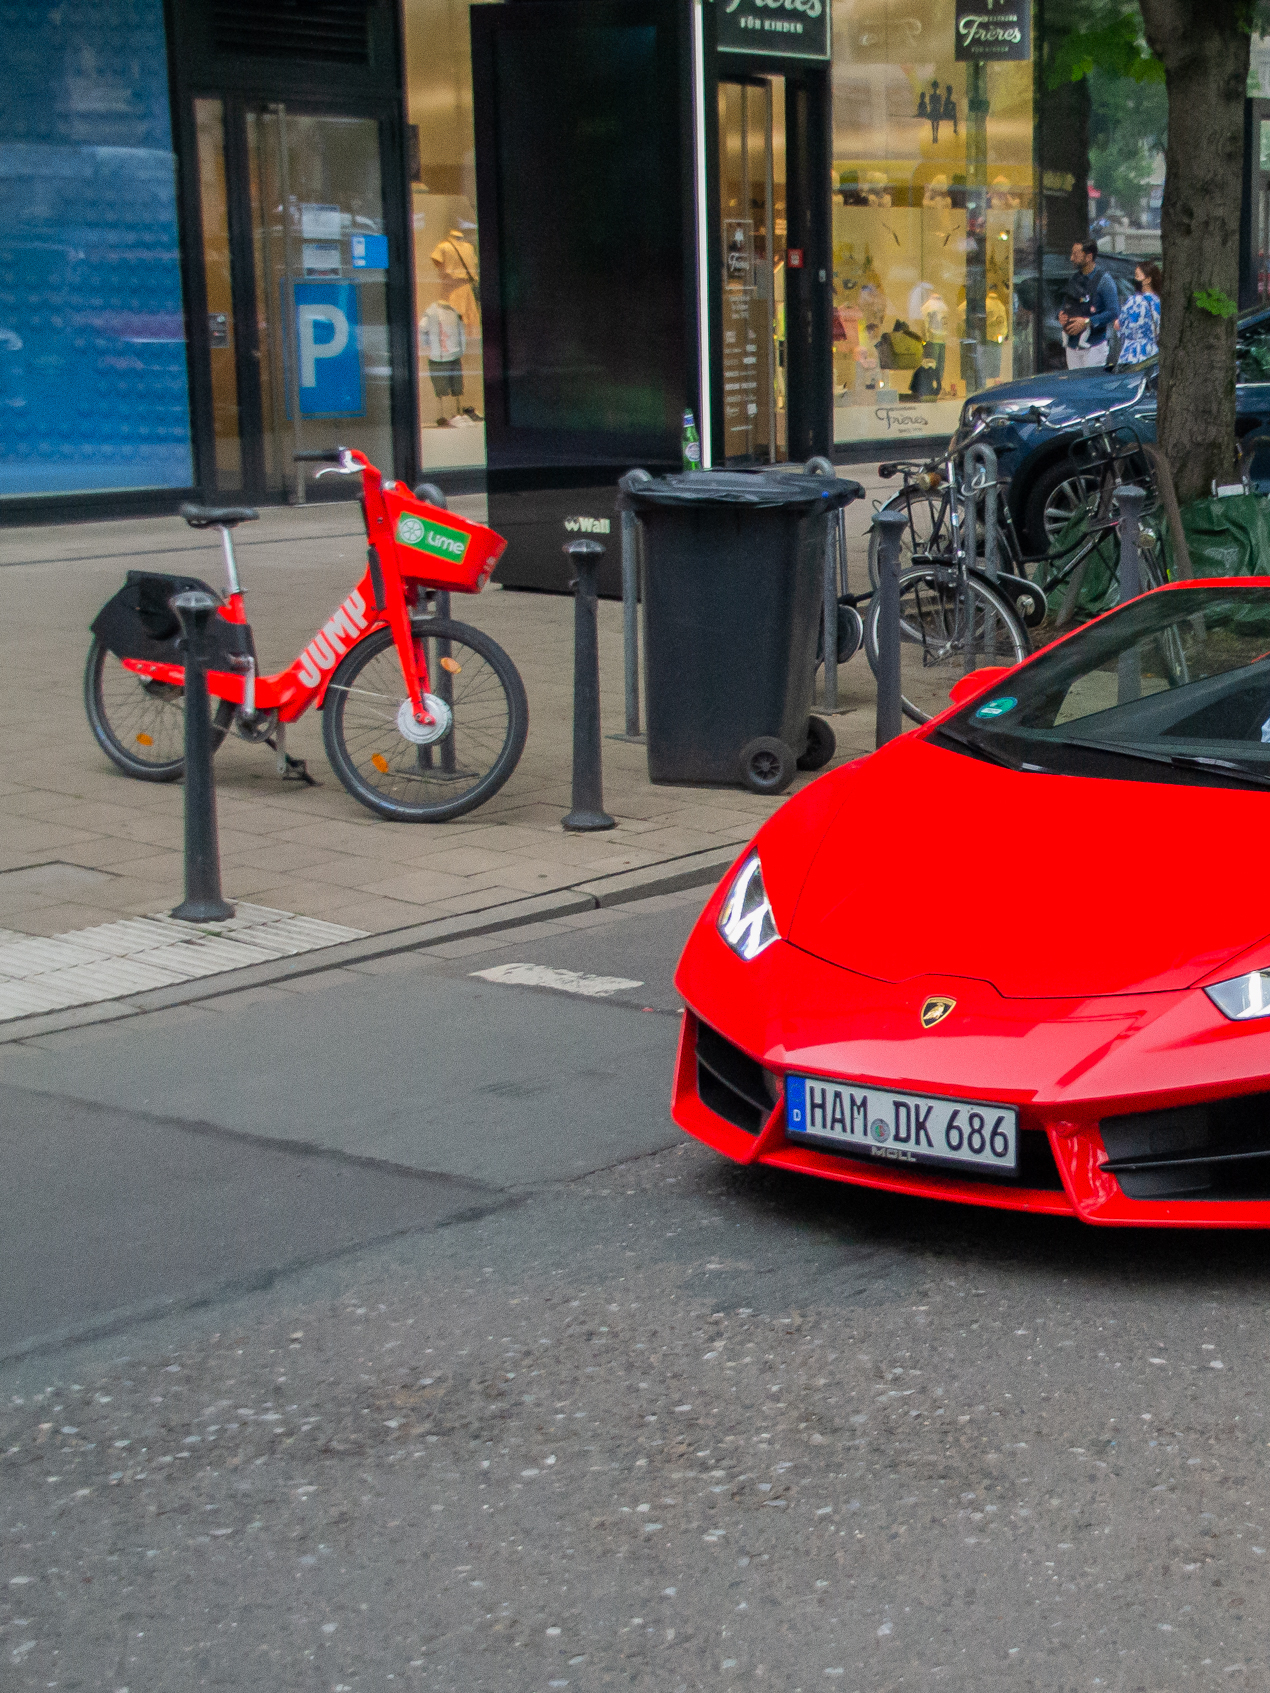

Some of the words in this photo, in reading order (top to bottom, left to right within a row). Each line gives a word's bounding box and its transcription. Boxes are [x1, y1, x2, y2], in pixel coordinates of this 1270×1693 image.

[764, 20, 804, 34] KINDER
[959, 15, 1021, 47] Frères
[299, 304, 349, 387] P
[578, 516, 611, 534] Wall
[298, 589, 369, 688] JUMP
[793, 1109, 801, 1121] D
[809, 1085, 868, 1137] HAM
[893, 1099, 934, 1148] DK
[945, 1108, 1010, 1158] 686
